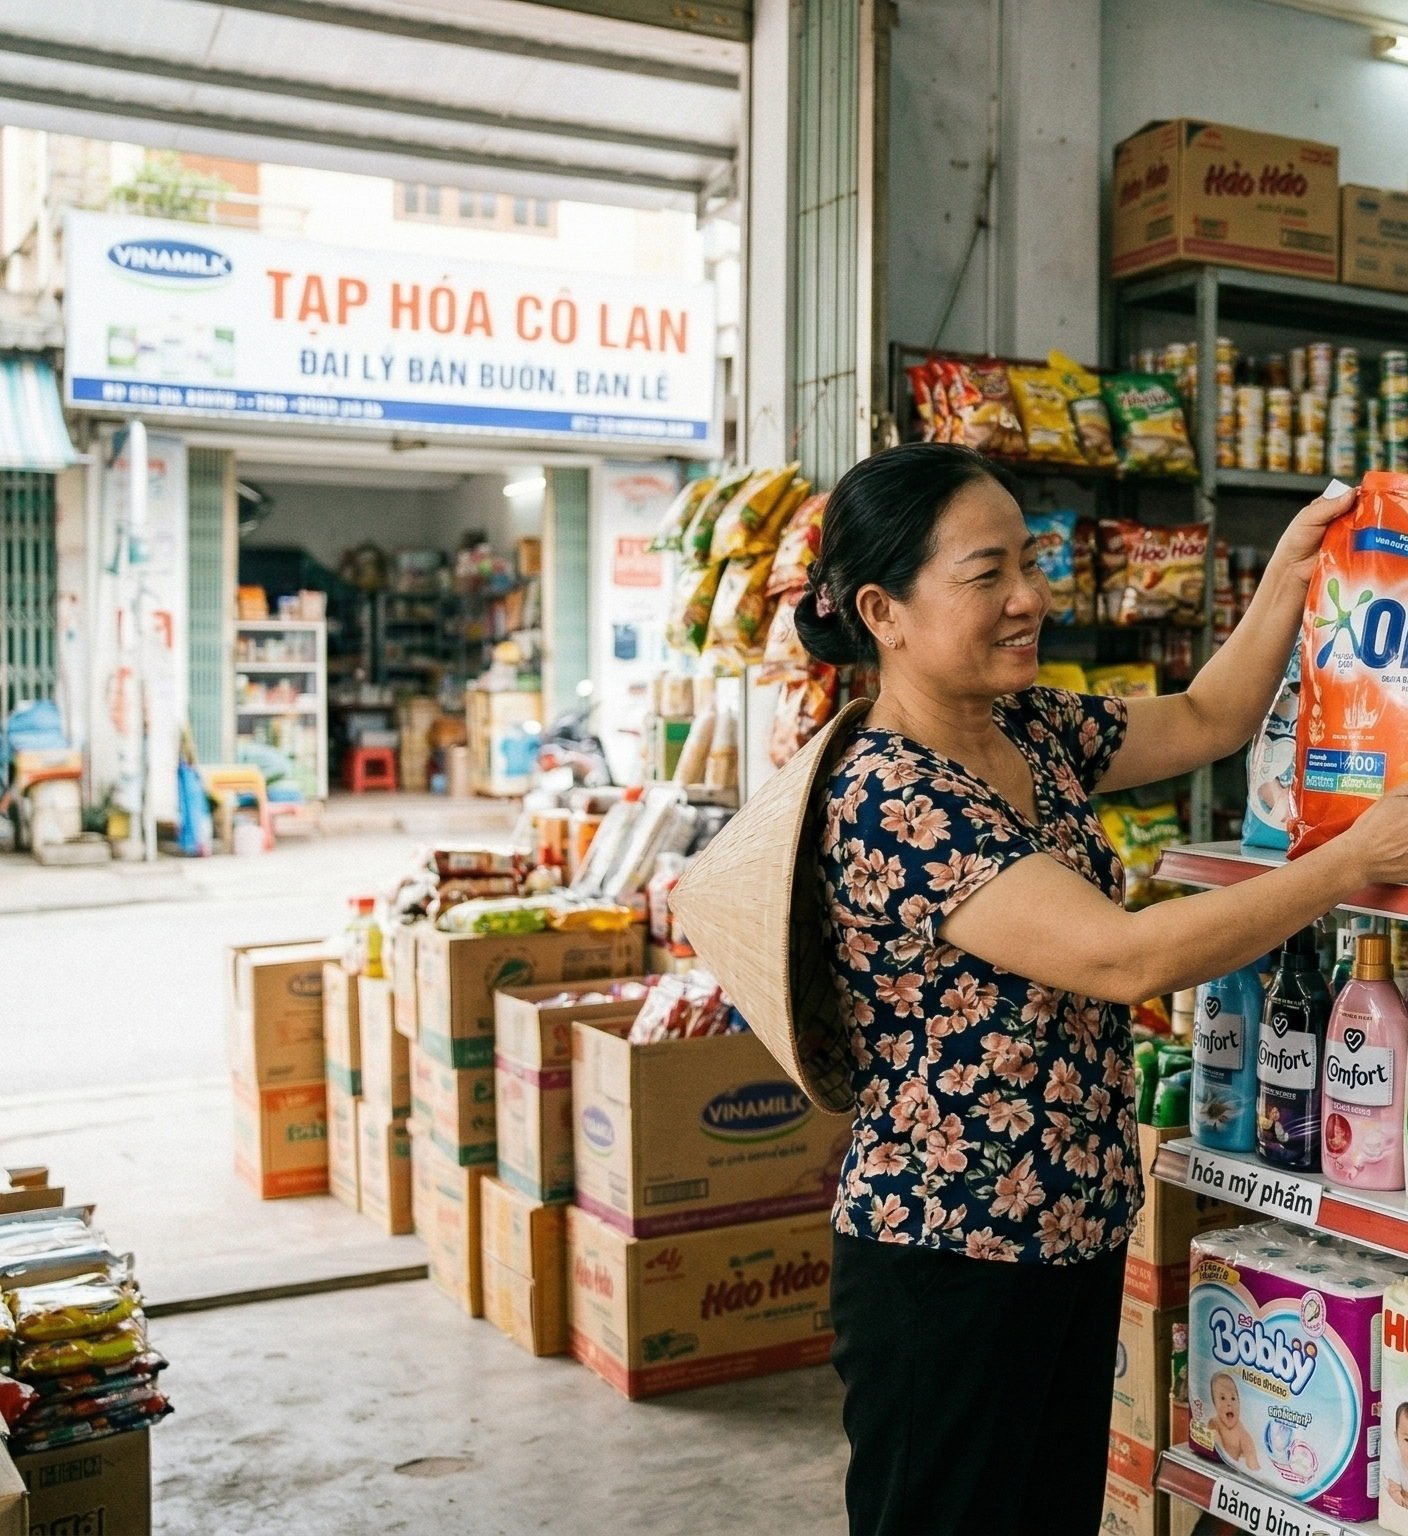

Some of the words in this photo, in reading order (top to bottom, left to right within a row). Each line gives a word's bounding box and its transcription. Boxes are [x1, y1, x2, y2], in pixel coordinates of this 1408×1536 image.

[113, 245, 229, 275] VINAMILK
[267, 270, 368, 334] TẠP
[516, 287, 578, 345] CÔ
[600, 303, 688, 353] LAN
[1257, 1039, 1312, 1073] Comfort
[1326, 1055, 1389, 1089] Comfort
[708, 1094, 806, 1124] VINAMILK
[1191, 1157, 1225, 1188] hóa
[1229, 1172, 1258, 1203] mỹ
[1259, 1181, 1313, 1216] phẩm
[702, 1270, 765, 1321] Hảo
[769, 1251, 830, 1299] Hảo
[1209, 1306, 1318, 1396] Bobby
[1217, 1484, 1261, 1532] băng
